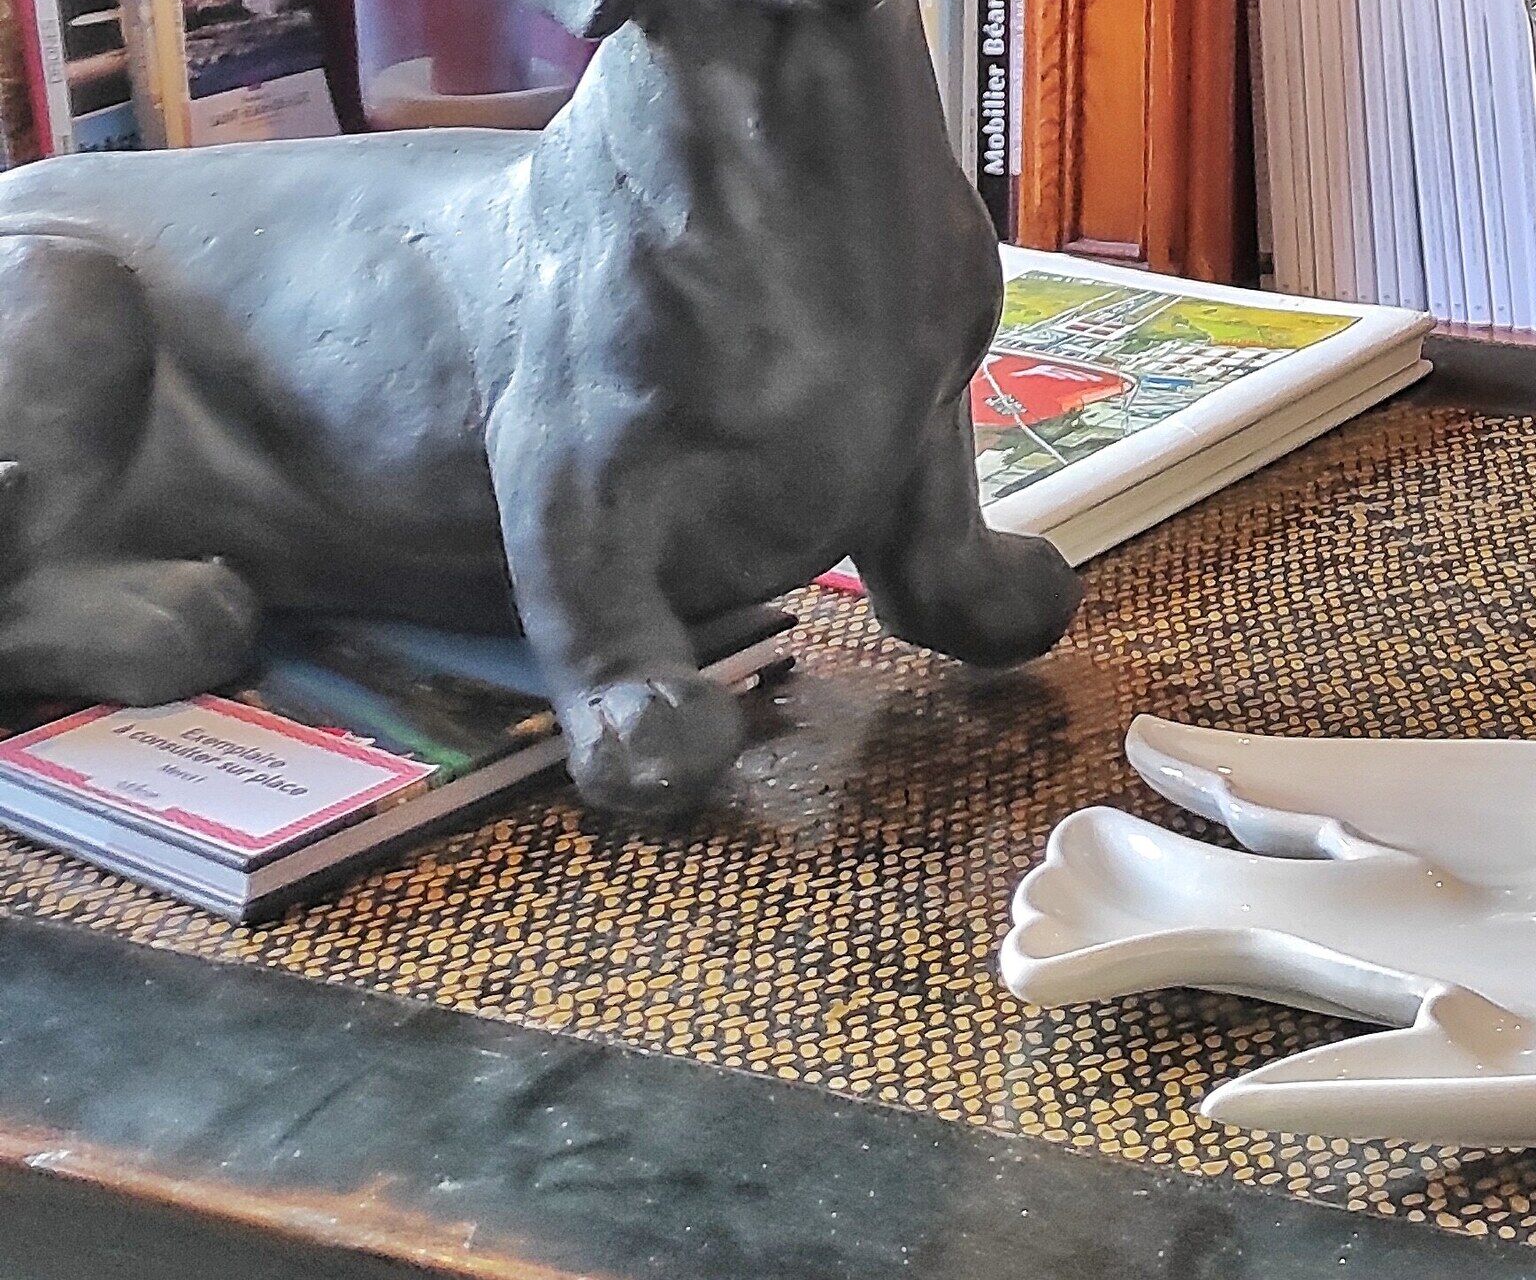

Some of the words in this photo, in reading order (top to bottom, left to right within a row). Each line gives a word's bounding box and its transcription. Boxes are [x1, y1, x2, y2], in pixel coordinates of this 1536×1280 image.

[981, 63, 1006, 176] Mobilier
[129, 730, 221, 766] consulter
[216, 761, 254, 776] sur
[243, 772, 309, 797] place
[180, 727, 286, 769] Exemplaire
